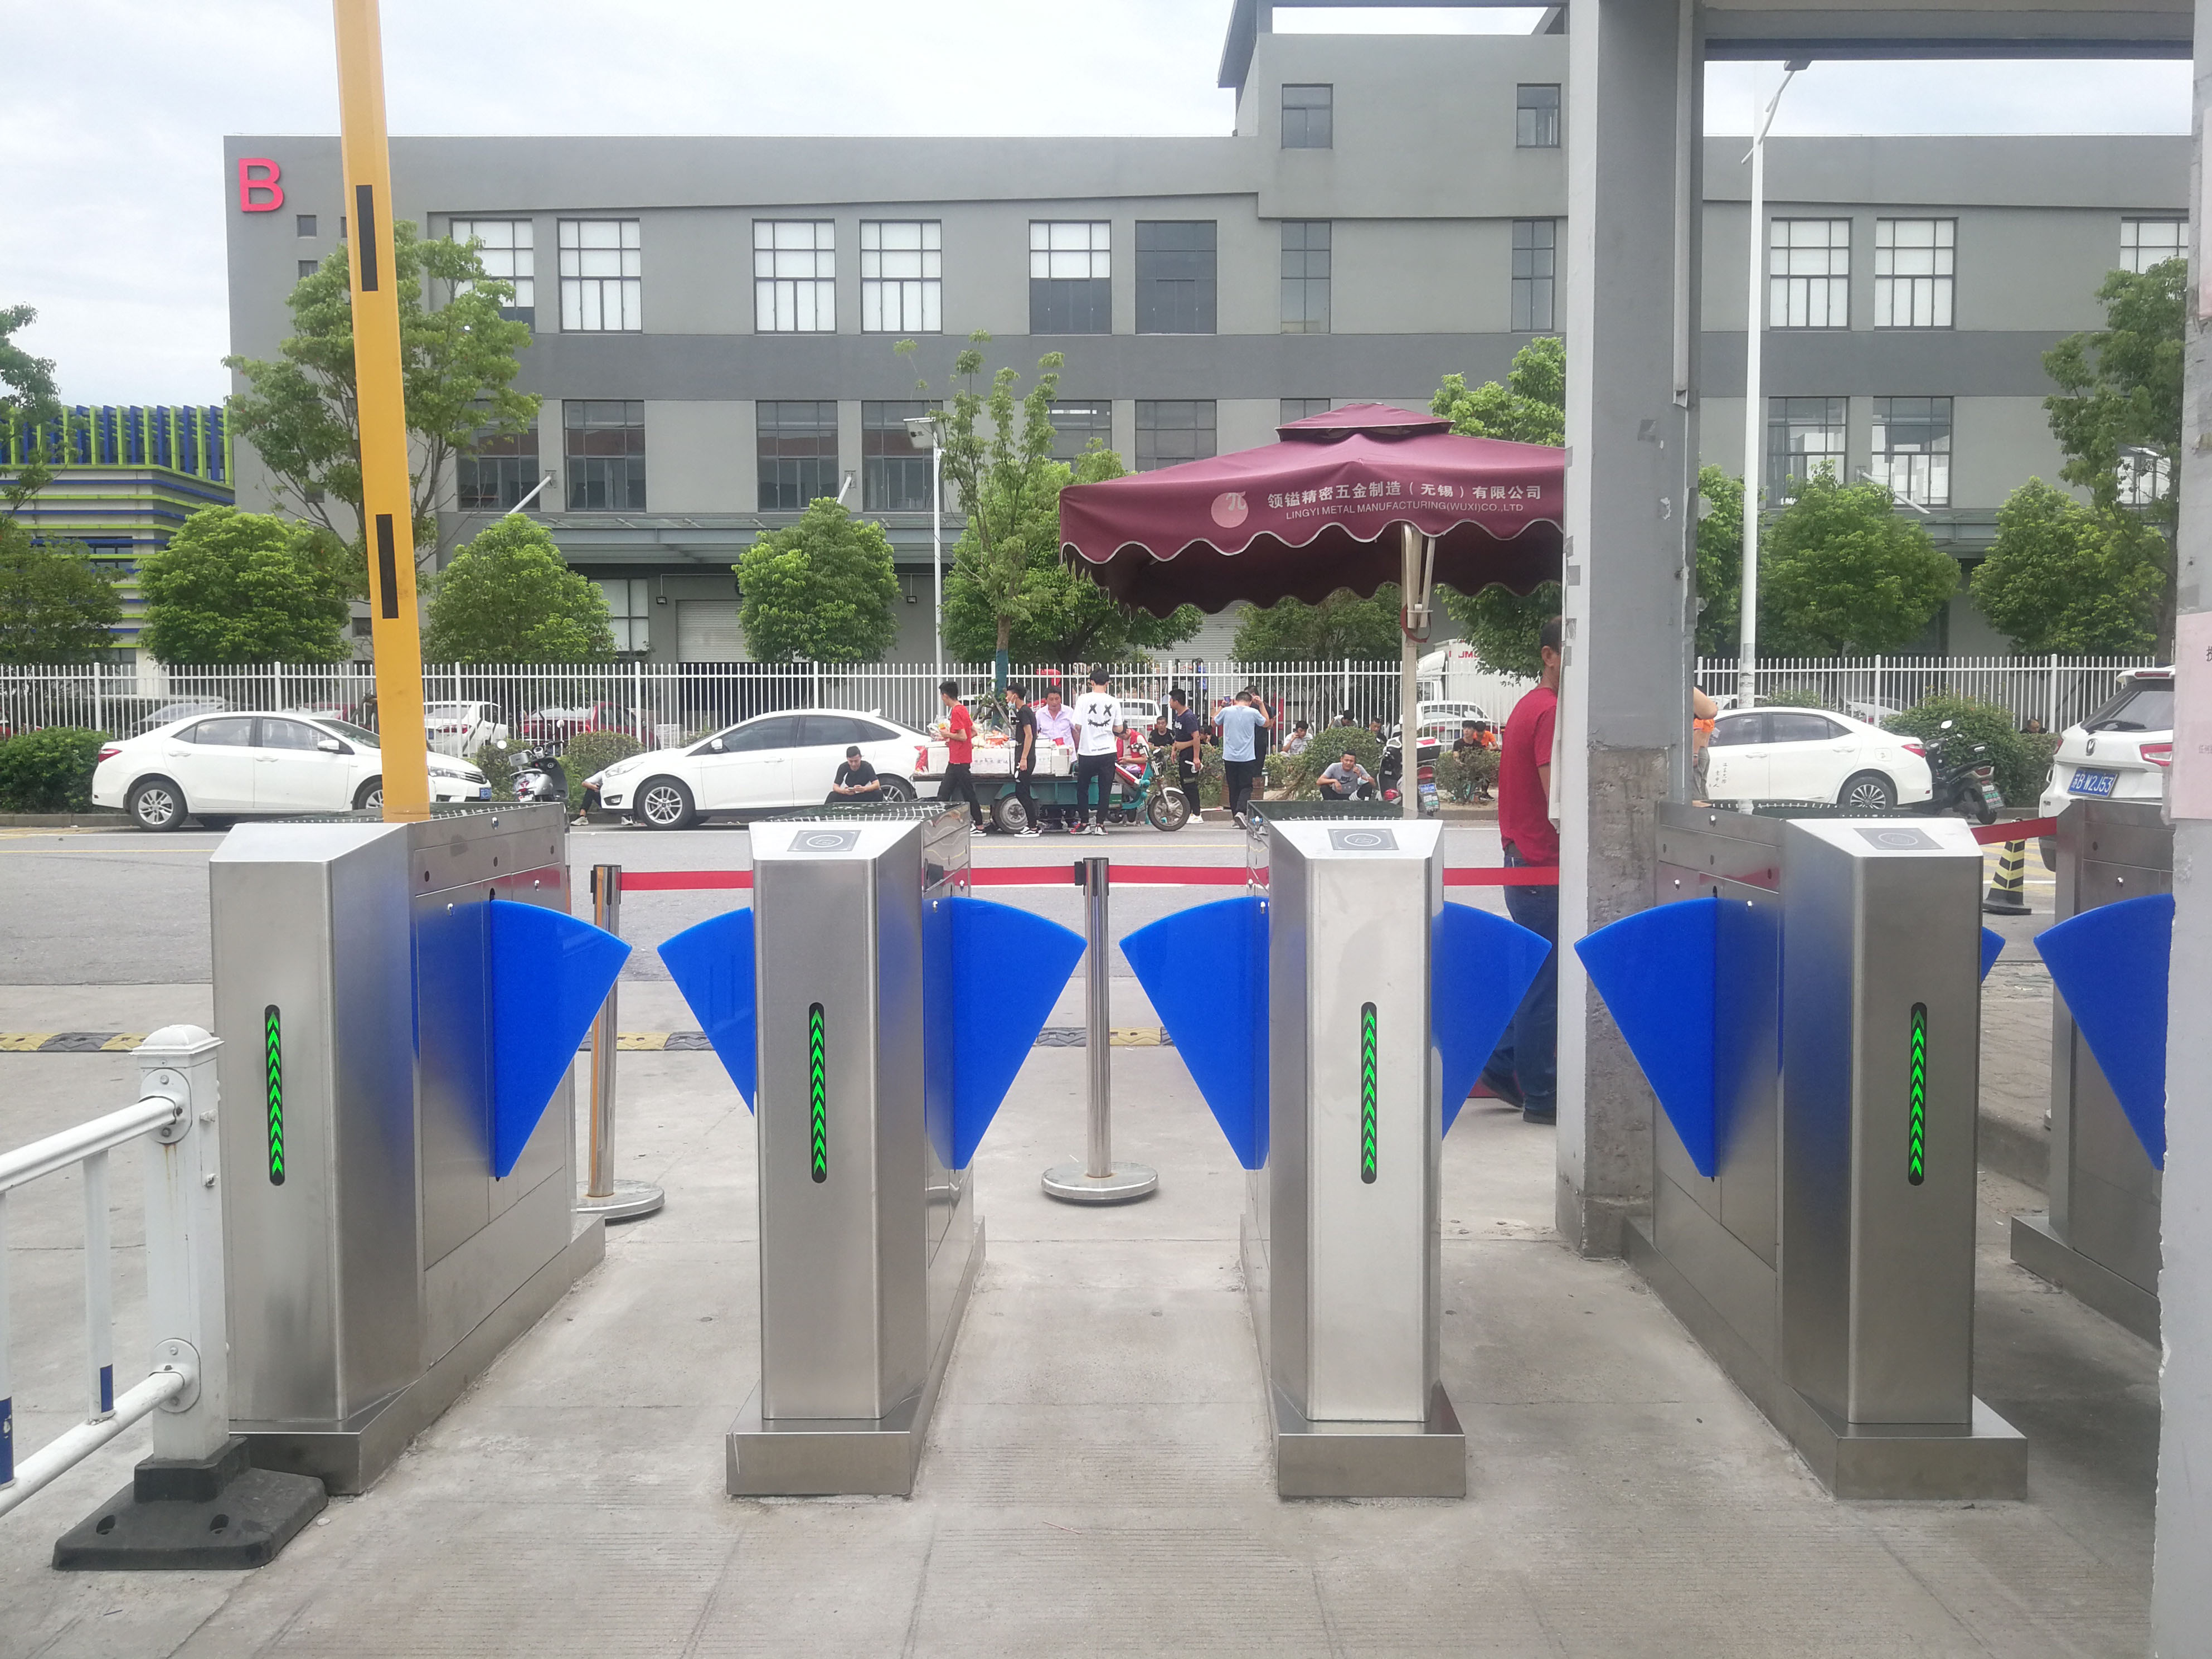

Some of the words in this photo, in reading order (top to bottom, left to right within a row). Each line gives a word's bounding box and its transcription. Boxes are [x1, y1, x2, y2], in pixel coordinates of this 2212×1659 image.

[238, 158, 284, 212] B
[1286, 507, 1320, 520] LINGYI
[1322, 505, 1356, 515] METAL
